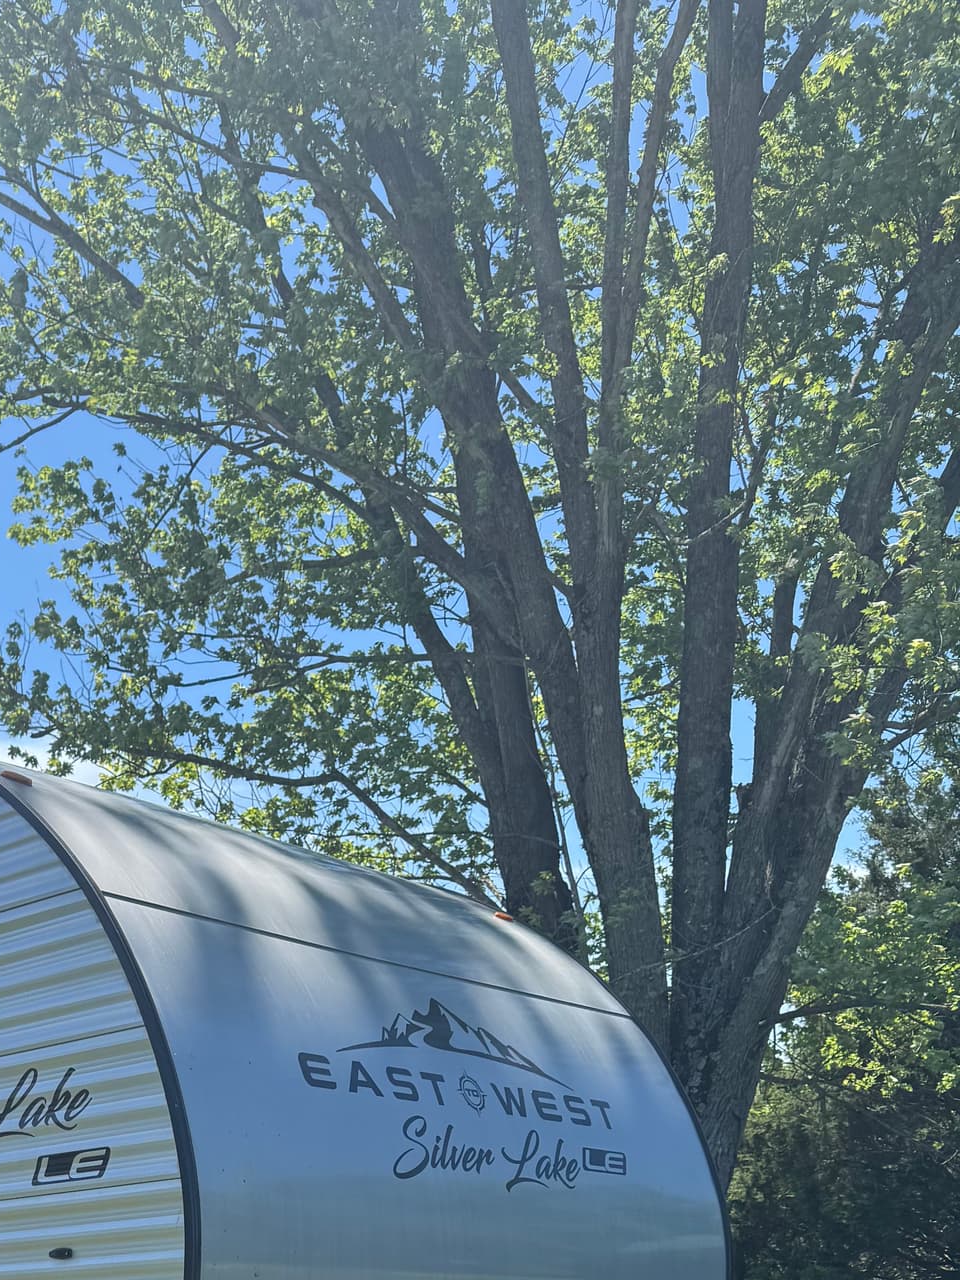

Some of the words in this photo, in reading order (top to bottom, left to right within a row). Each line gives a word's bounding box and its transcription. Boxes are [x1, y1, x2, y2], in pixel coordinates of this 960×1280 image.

[298, 1052, 445, 1105] EAST
[489, 1083, 613, 1130] WEST
[33, 1147, 110, 1185] LE
[393, 1115, 495, 1179] Silver
[501, 1130, 581, 1192] Lake
[583, 1147, 626, 1175] LE
